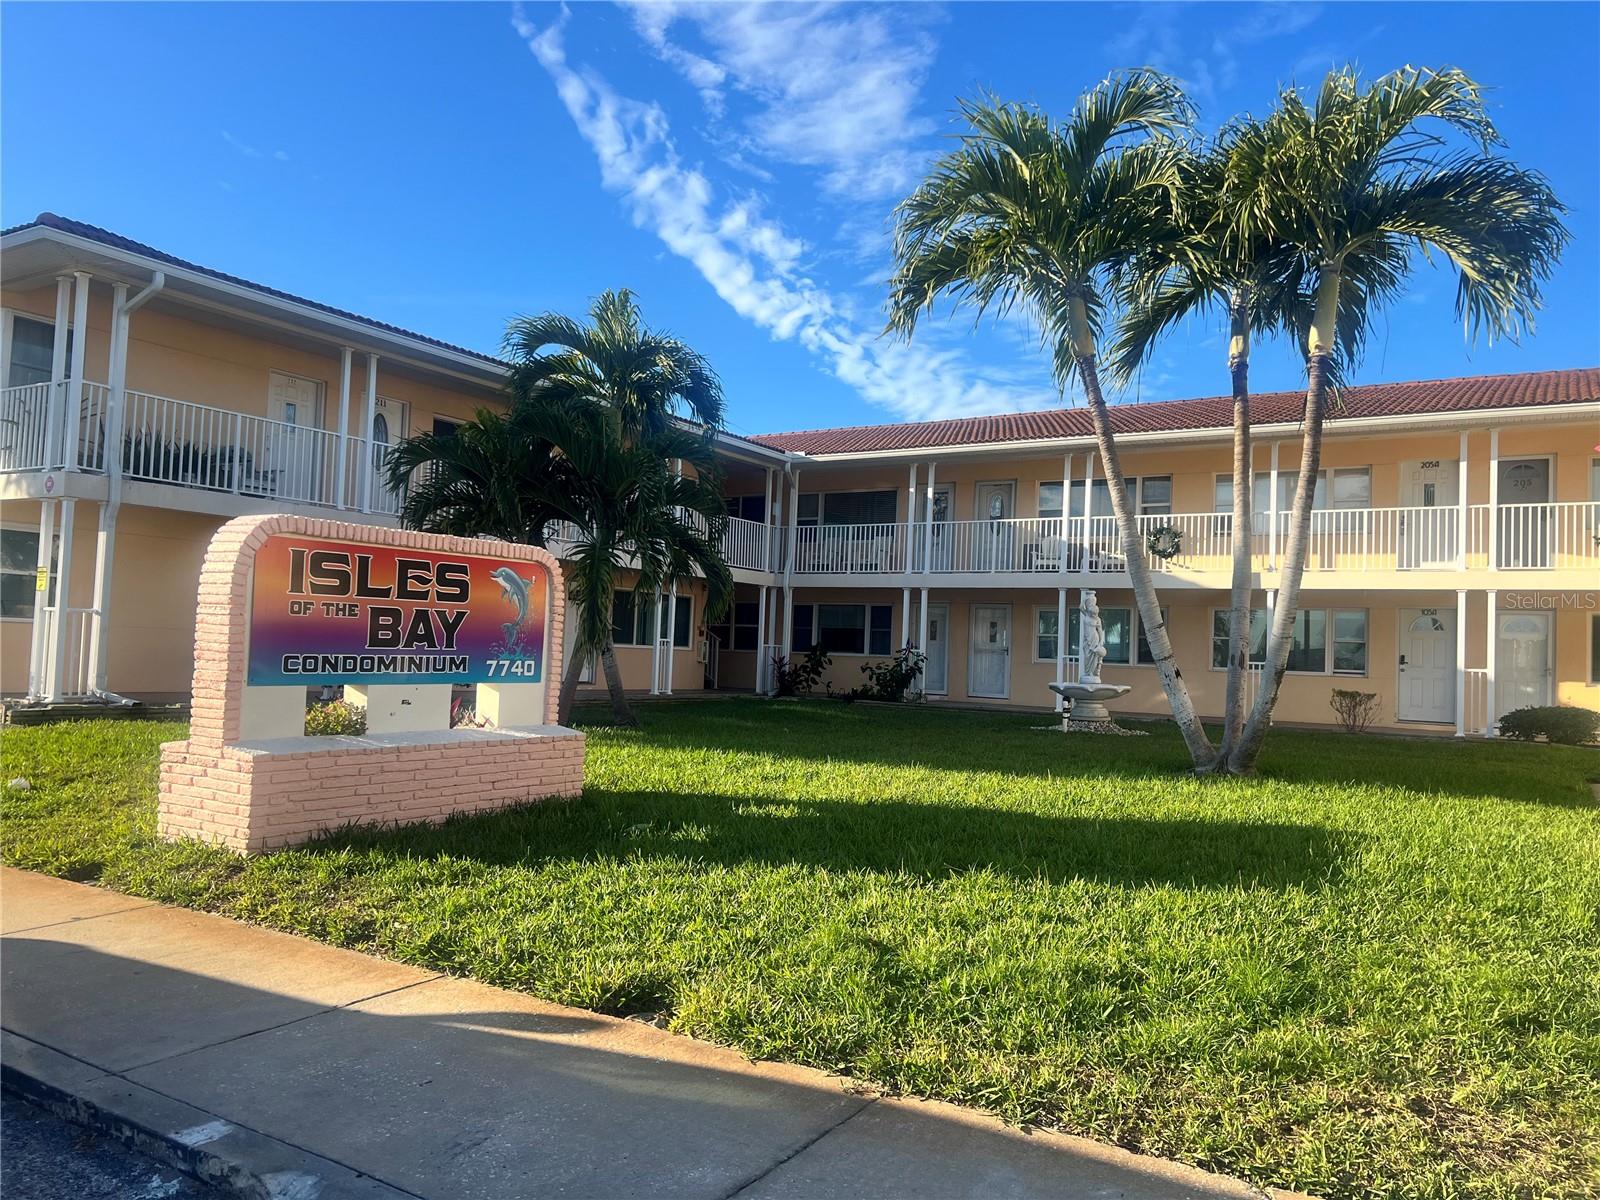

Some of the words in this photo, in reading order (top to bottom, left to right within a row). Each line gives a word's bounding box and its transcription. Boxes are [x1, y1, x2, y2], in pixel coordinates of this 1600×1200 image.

[288, 548, 470, 604] ISLES
[289, 600, 315, 616] OF
[321, 602, 360, 618] THE
[366, 605, 470, 650] BAY
[282, 654, 469, 674] CONDOMINIUM
[485, 660, 535, 677] 7740
